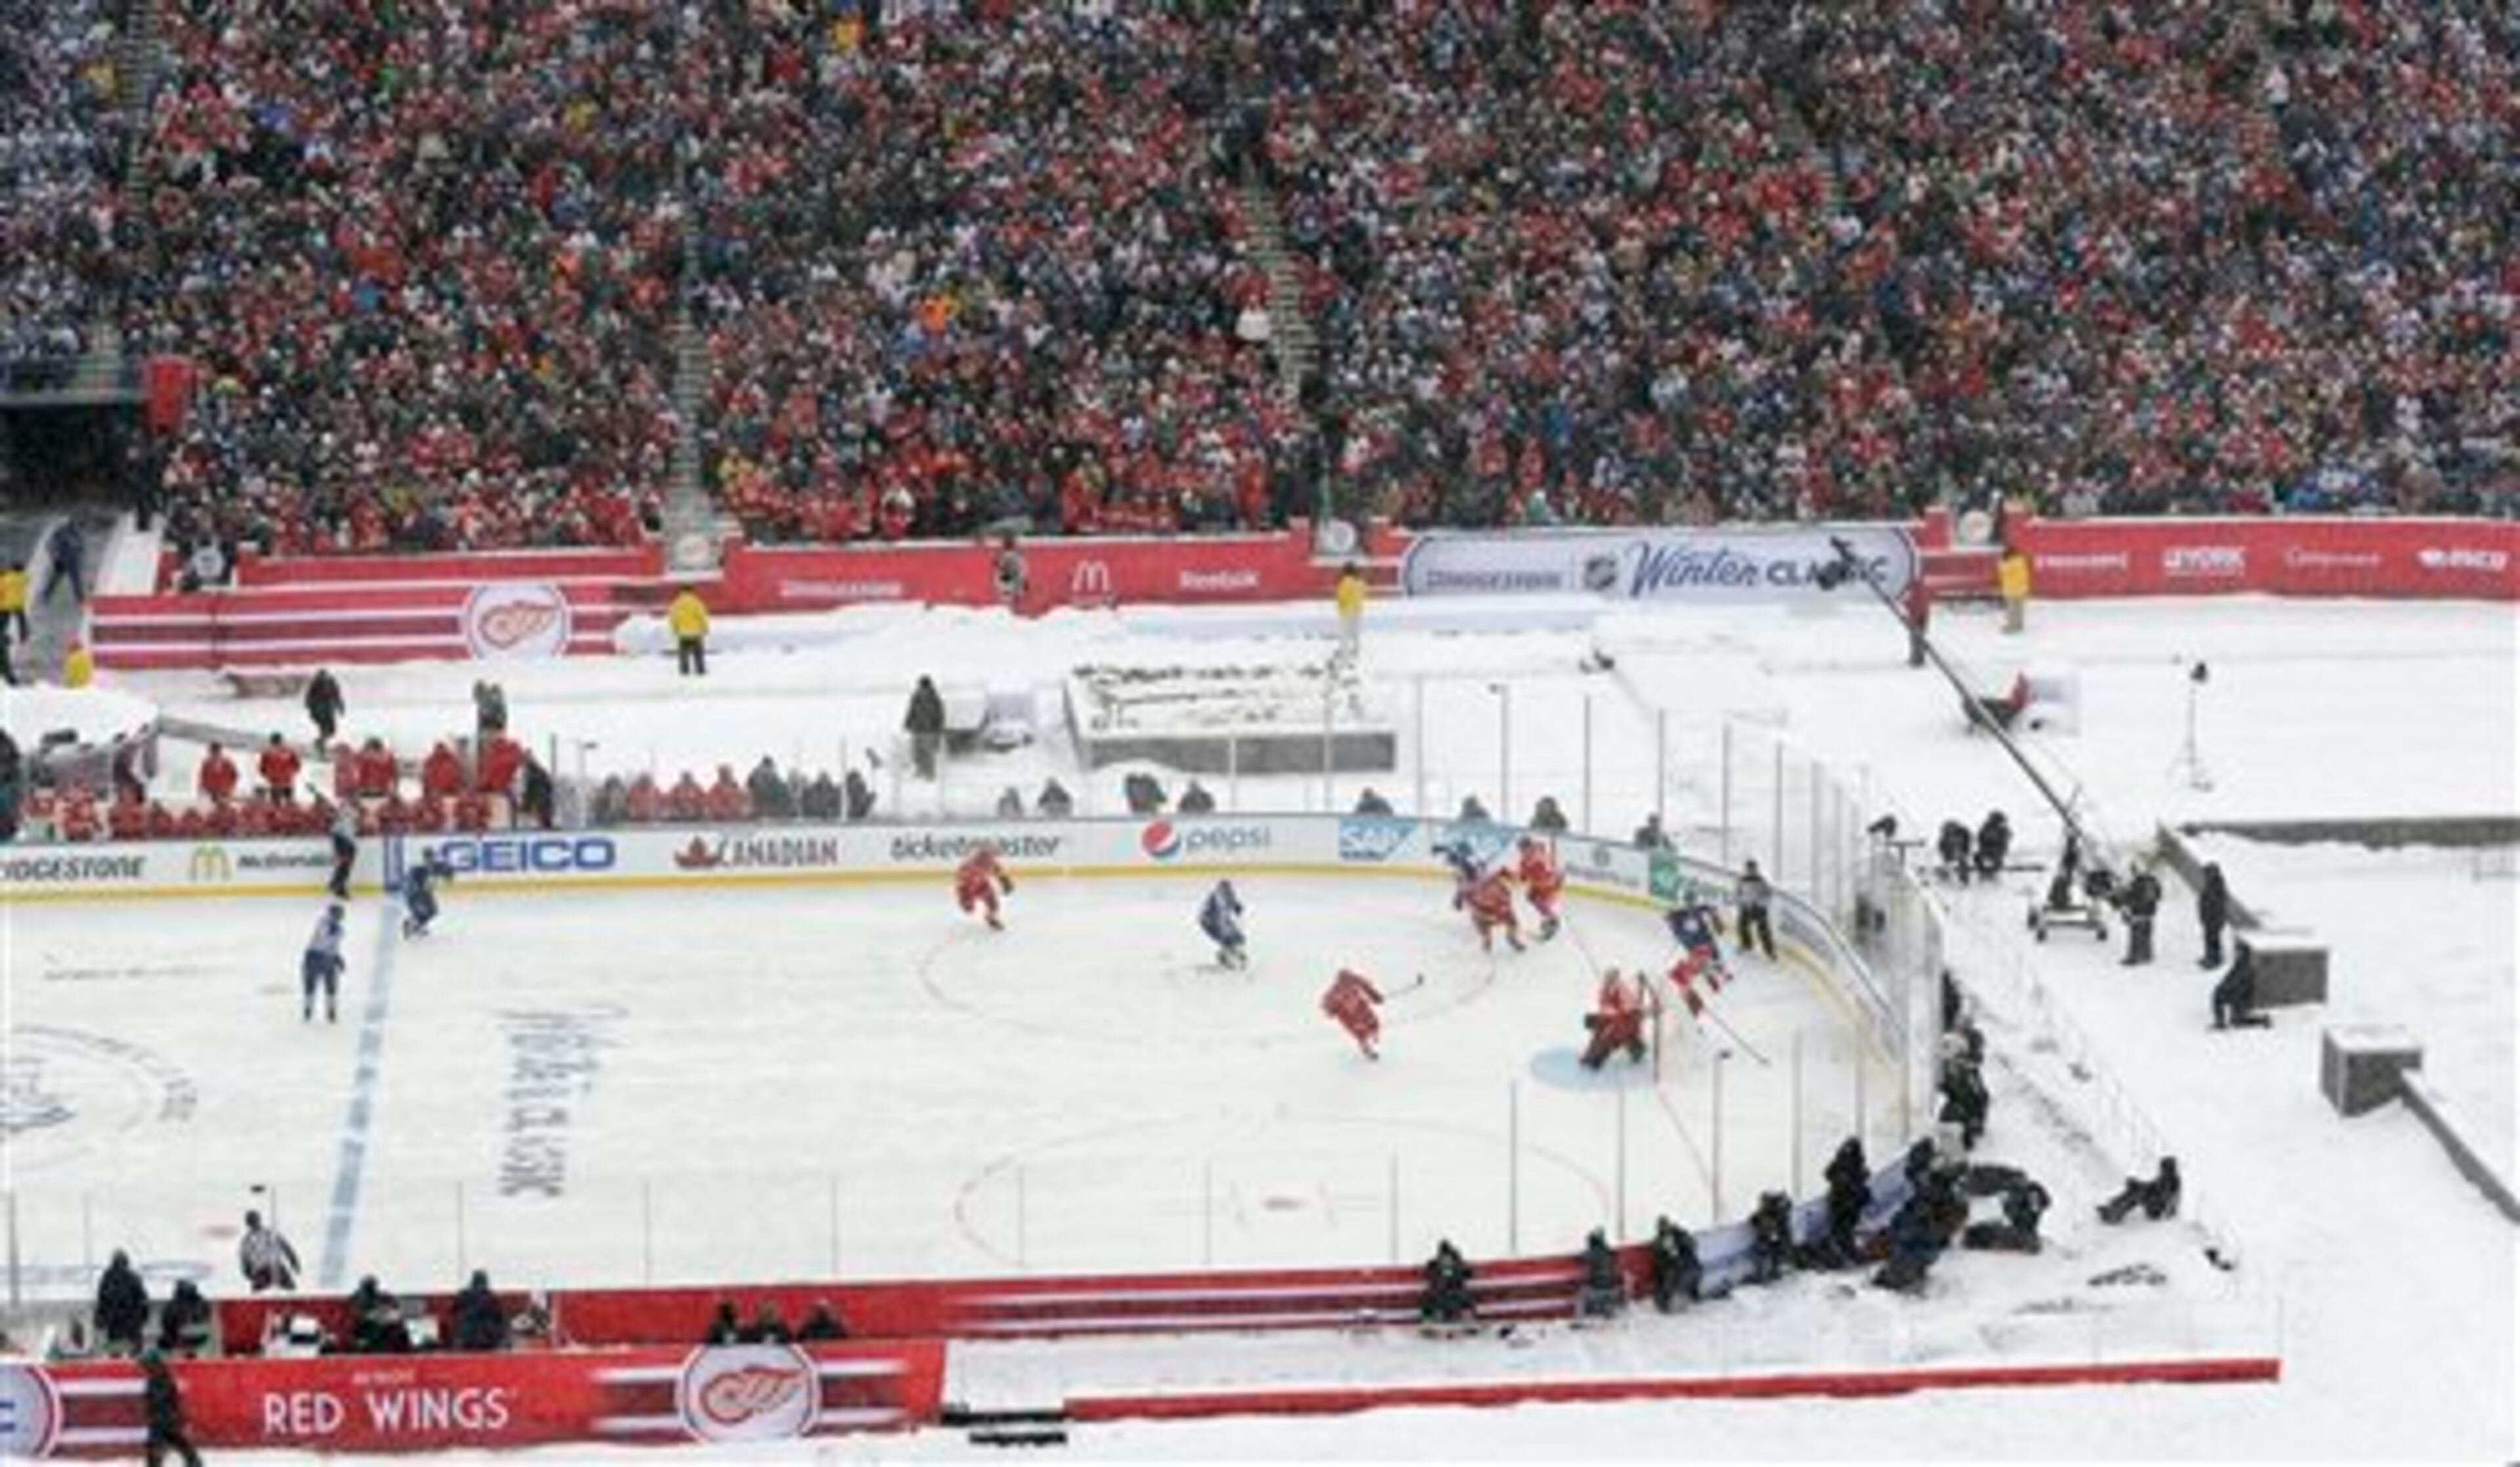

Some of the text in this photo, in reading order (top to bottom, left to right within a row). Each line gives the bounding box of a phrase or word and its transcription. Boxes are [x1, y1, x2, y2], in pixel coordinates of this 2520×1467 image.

[1624, 541, 1759, 598] Winter
[441, 837, 616, 872] GEICO
[717, 836, 838, 867] CANADIAN
[1186, 826, 1271, 853] pepsi
[0, 855, 148, 881] IDGESTONE
[264, 1388, 510, 1434] RED WINGS
